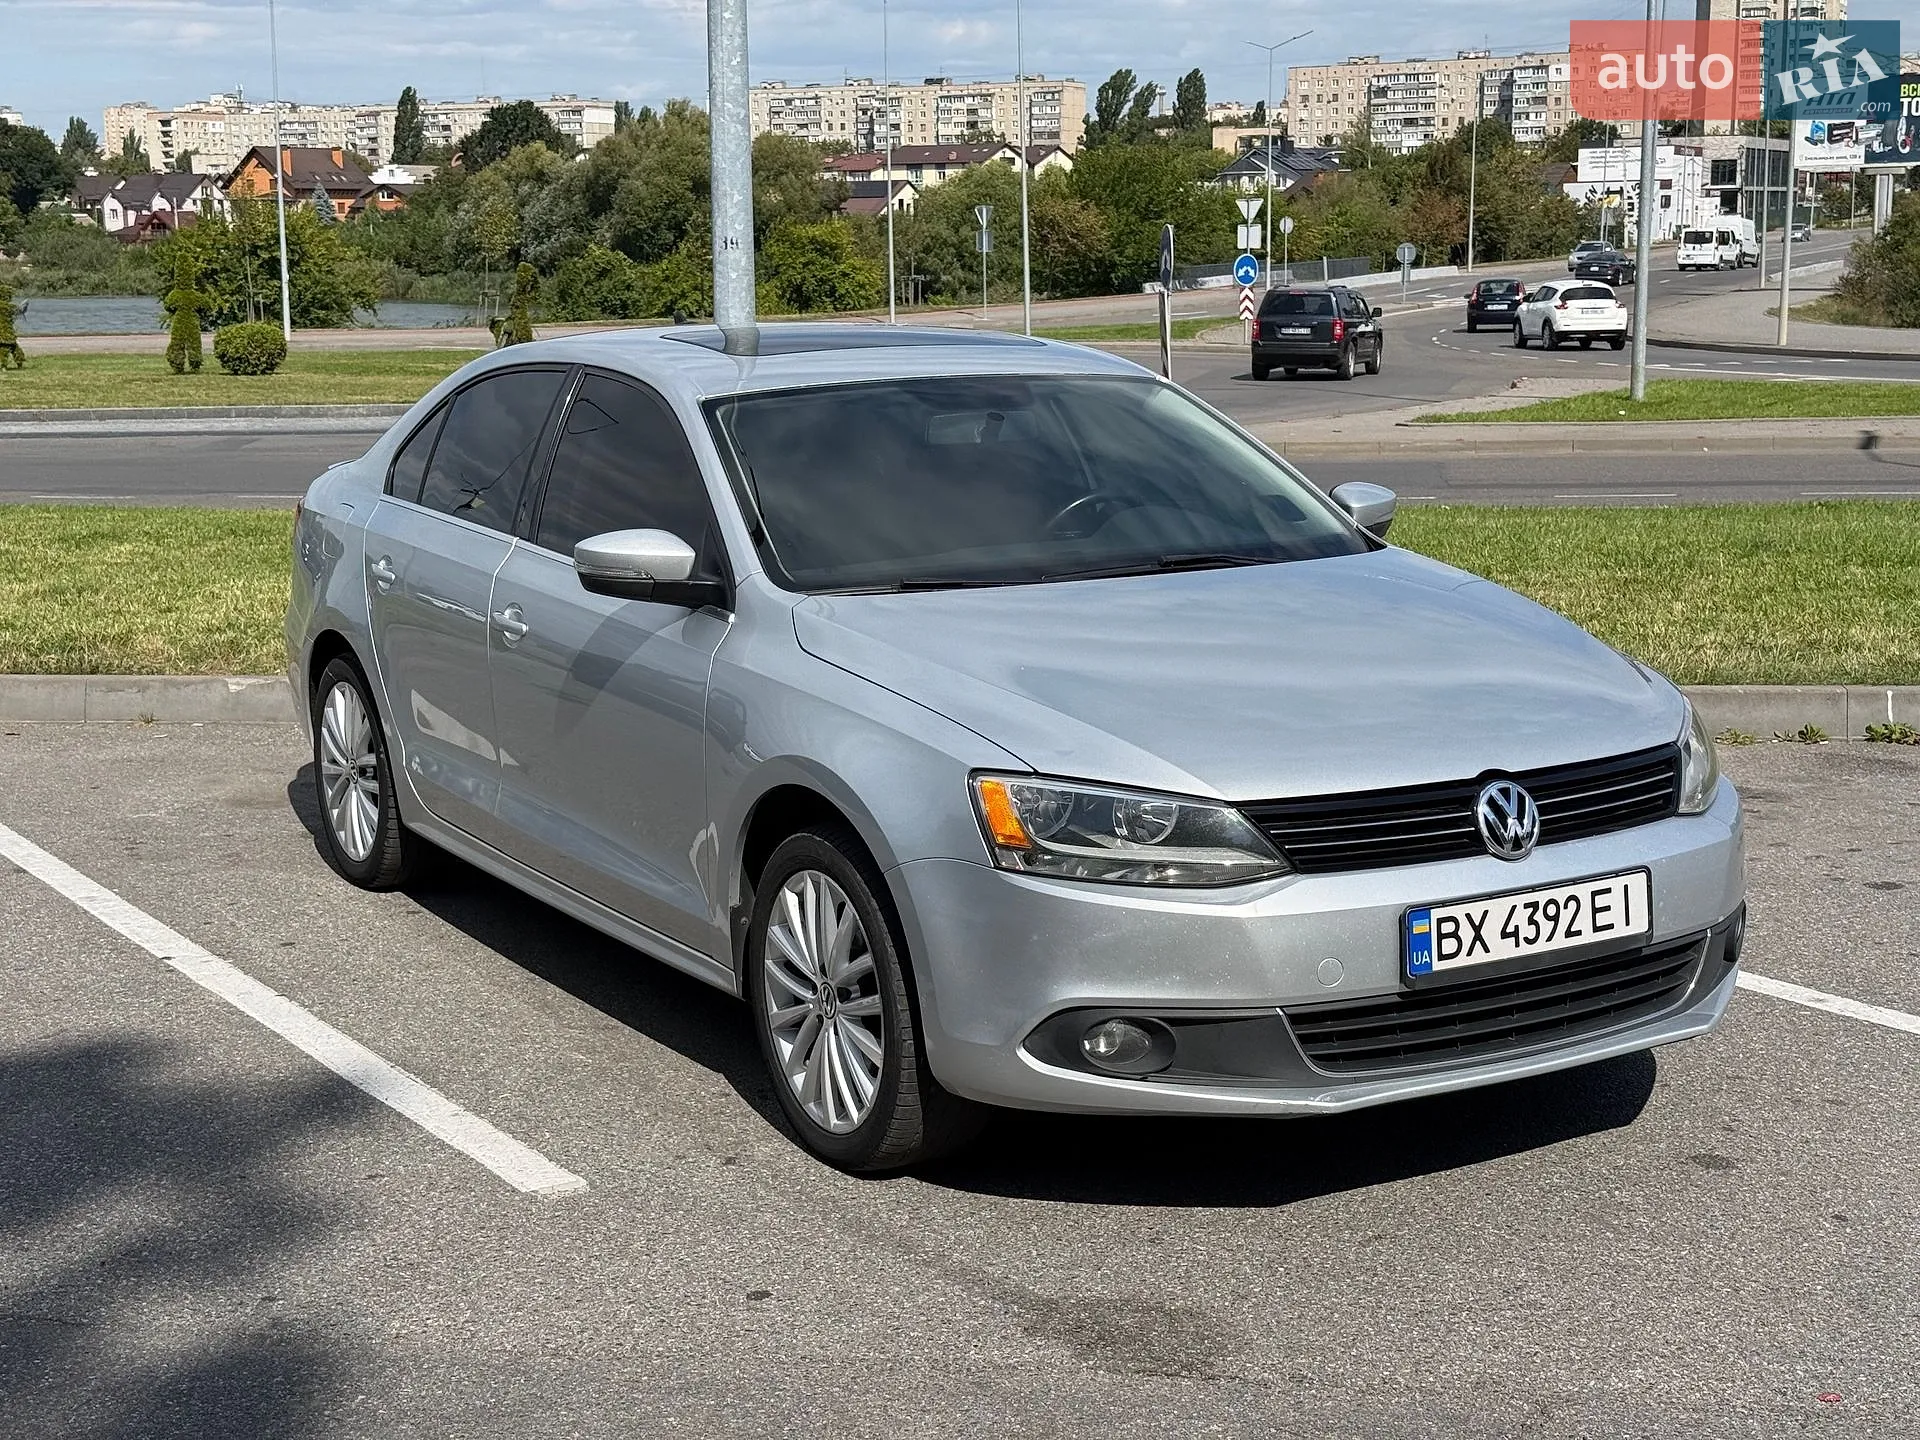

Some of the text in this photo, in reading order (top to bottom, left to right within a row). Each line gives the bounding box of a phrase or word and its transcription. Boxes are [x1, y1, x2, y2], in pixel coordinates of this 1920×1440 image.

[1436, 884, 1631, 962] BX 4392 EI
[1413, 950, 1431, 965] UA
